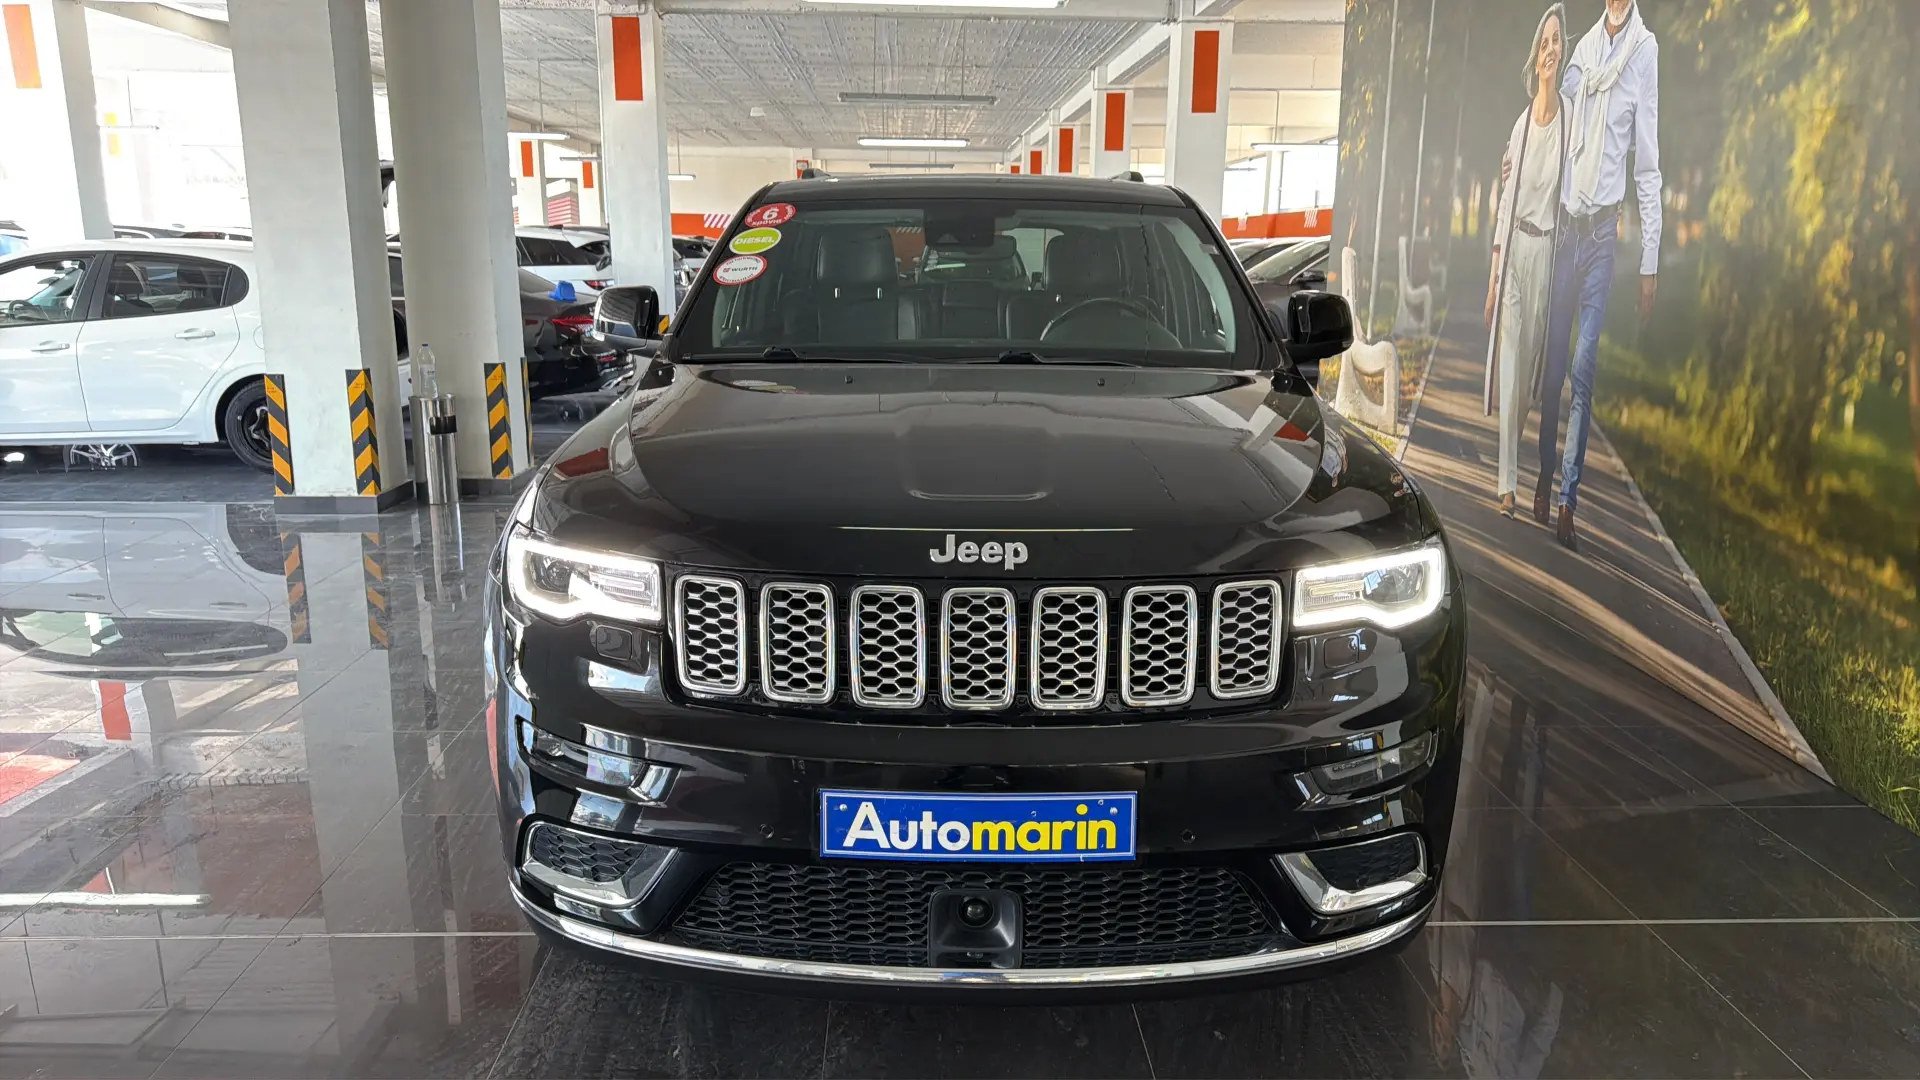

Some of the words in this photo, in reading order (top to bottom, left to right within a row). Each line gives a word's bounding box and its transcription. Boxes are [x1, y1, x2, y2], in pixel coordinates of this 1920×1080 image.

[763, 207, 779, 221] 6
[734, 236, 775, 245] DIESEL
[930, 534, 1028, 571] Jeep
[842, 801, 1117, 851] Automarin
